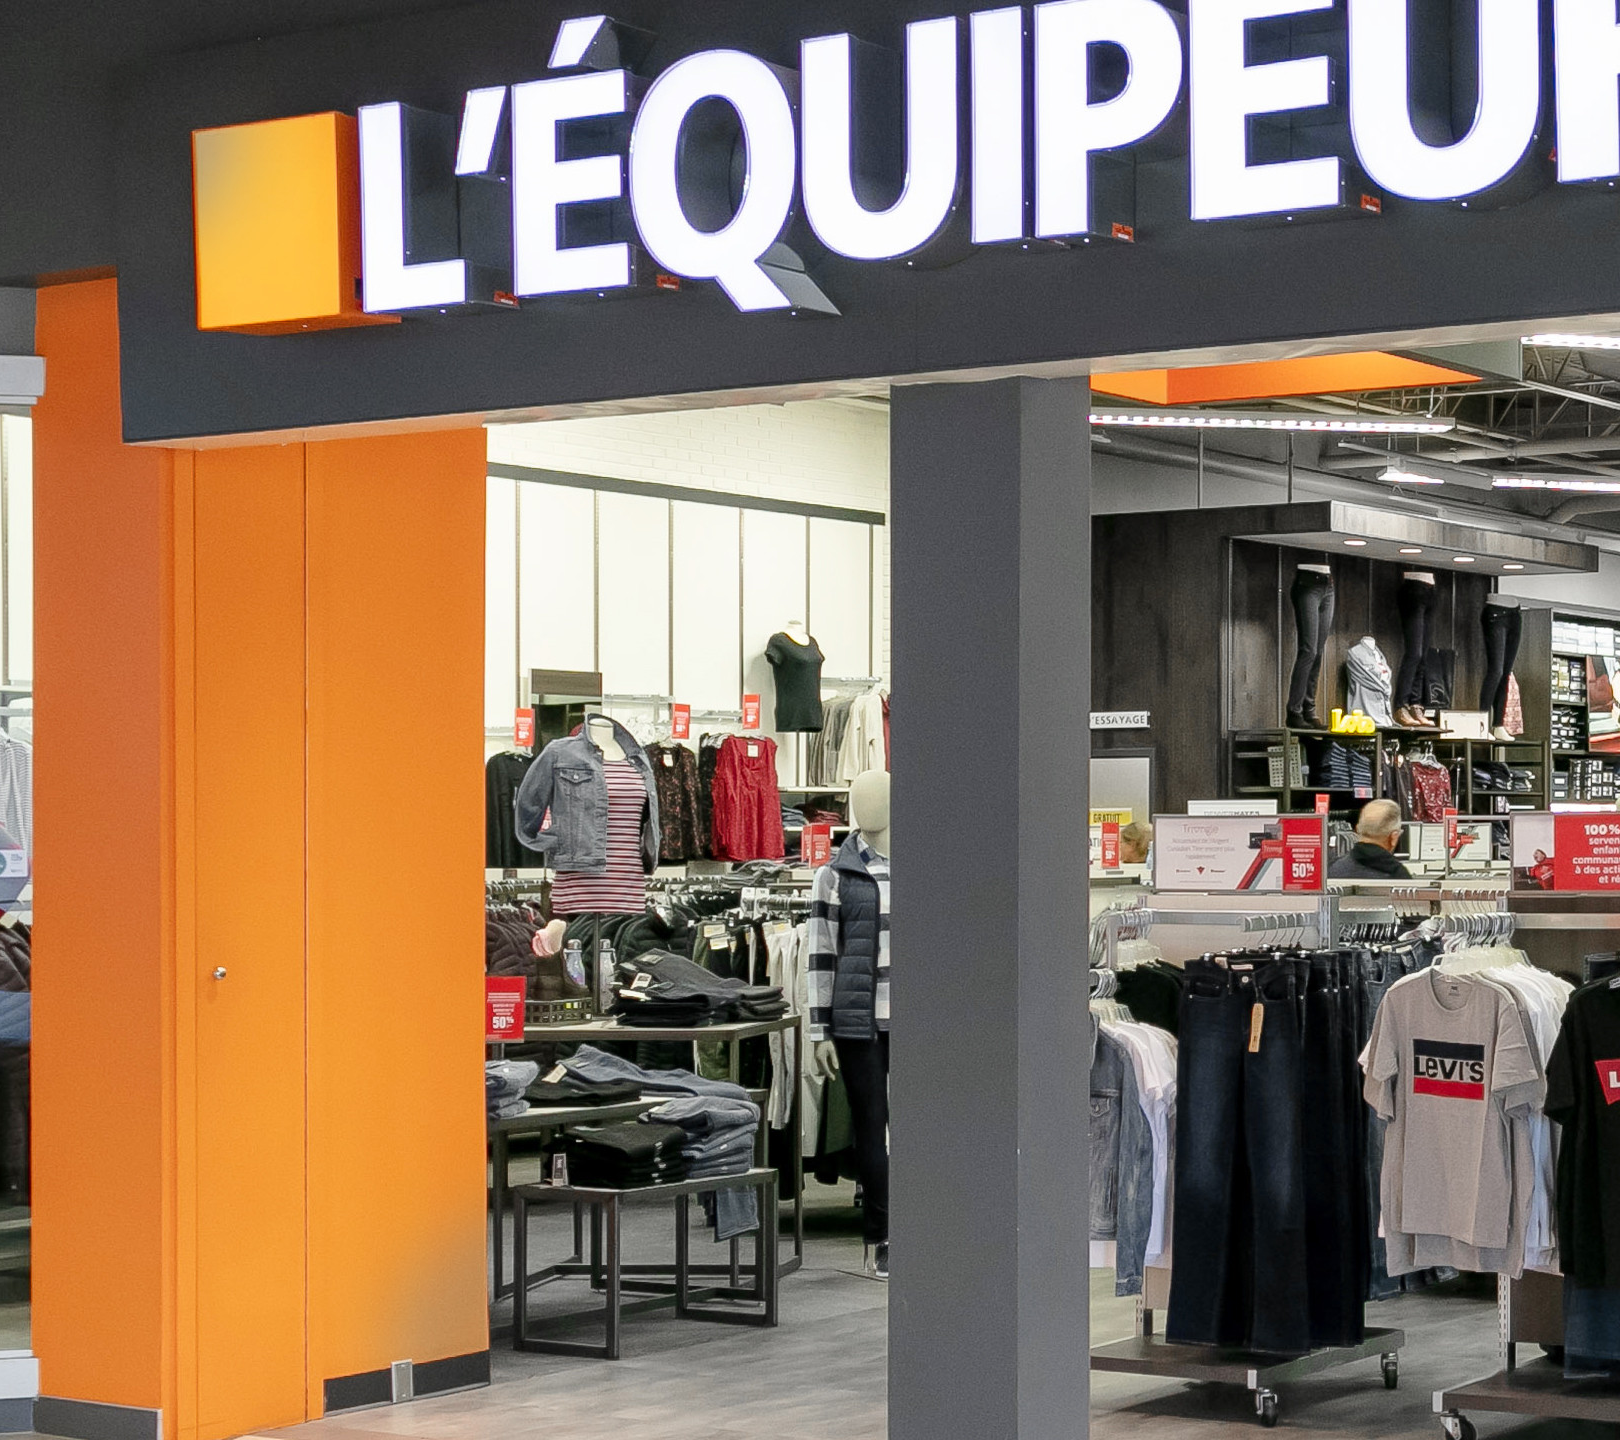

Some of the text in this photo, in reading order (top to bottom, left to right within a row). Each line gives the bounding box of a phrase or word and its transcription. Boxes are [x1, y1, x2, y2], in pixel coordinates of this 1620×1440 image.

[1584, 825, 1607, 835] 100
[1574, 865, 1580, 874] à
[1584, 865, 1601, 874] des
[1598, 876, 1609, 884] et
